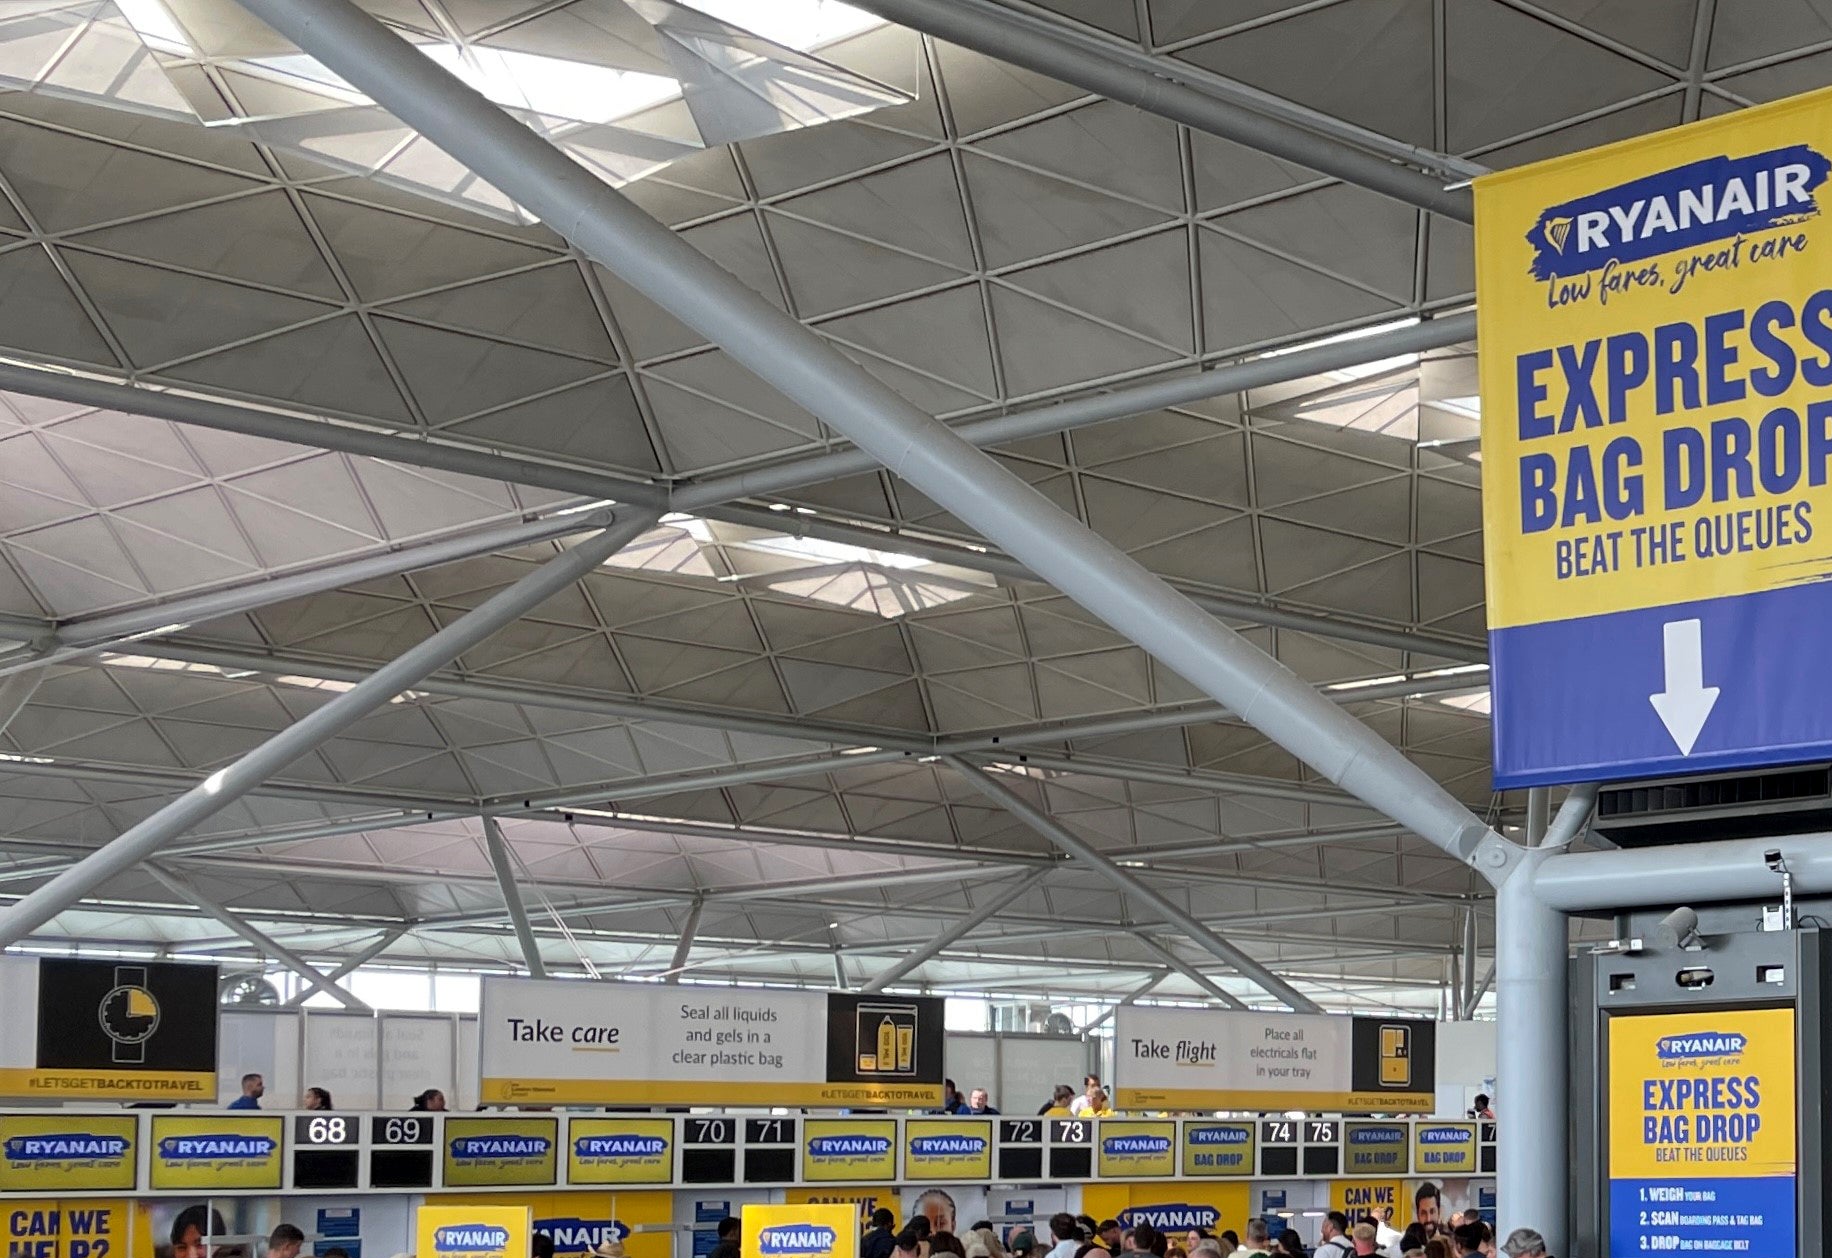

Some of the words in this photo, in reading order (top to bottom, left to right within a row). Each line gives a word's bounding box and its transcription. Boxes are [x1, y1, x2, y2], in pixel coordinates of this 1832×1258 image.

[1577, 163, 1811, 254] RYANAIR
[1547, 270, 1592, 308] Low
[1600, 260, 1666, 306] fares,
[1670, 246, 1742, 294] great
[1750, 230, 1808, 264] care
[1519, 436, 1644, 536] BAG
[1555, 519, 1626, 581] BEAT
[1630, 512, 1686, 567] THE
[1693, 500, 1812, 559] QUEUES
[681, 1004, 710, 1020] Seal
[713, 1006, 729, 1020] all
[733, 1006, 778, 1024] liquids
[507, 1018, 564, 1043] Take
[571, 1026, 620, 1044] care
[685, 1028, 711, 1043] and
[716, 1028, 743, 1046] gels
[747, 1030, 758, 1043] in
[763, 1033, 771, 1043] a
[1265, 1028, 1290, 1040] Place
[1293, 1029, 1304, 1040] all
[1132, 1039, 1170, 1058] Take
[1175, 1040, 1217, 1063] flight
[1671, 1038, 1742, 1053] RYANAIR
[672, 1050, 705, 1065] clear
[710, 1050, 755, 1068] plastic
[758, 1052, 783, 1068] bag
[1250, 1047, 1299, 1059] electricals
[1301, 1049, 1317, 1060] flat
[1662, 1059, 1676, 1068] Low
[1723, 1058, 1741, 1066] care
[1256, 1066, 1266, 1075] in
[1268, 1067, 1290, 1079] your
[1292, 1068, 1311, 1080] tray
[29, 1077, 203, 1091] #LETSGETBACKTOTRAVEL
[1643, 1076, 1761, 1110] EXPRESS
[309, 1118, 346, 1143] 68
[385, 1119, 420, 1143] 69
[695, 1120, 725, 1142] 70
[757, 1120, 782, 1142] 71
[1009, 1121, 1034, 1142] 72
[1060, 1121, 1084, 1142] 73
[1199, 1130, 1247, 1141] RYANAIR
[1270, 1123, 1290, 1142] 74
[1312, 1123, 1332, 1142] 75
[1428, 1131, 1470, 1141] RYANAIR
[1488, 1125, 1497, 1141] 7
[1644, 1115, 1689, 1144] BAG
[1696, 1113, 1761, 1143] DROP
[923, 1138, 983, 1150] RYANAIR
[1358, 1132, 1402, 1141] RYANAIR
[25, 1140, 124, 1154] RYANAIR
[178, 1140, 270, 1154] RYANAIR
[467, 1141, 547, 1153] RYANAIR
[590, 1141, 664, 1153] RYANAIR
[822, 1141, 888, 1152] RYANAIR
[1114, 1140, 1168, 1150] RYANAIR
[1194, 1154, 1214, 1166] BAG
[1217, 1154, 1243, 1166] DROP
[1355, 1153, 1373, 1164] BAG
[1374, 1152, 1398, 1164] DROP
[1424, 1152, 1442, 1163] BAG
[1443, 1152, 1466, 1163] DROP
[1656, 1148, 1681, 1162] BEAT
[1683, 1148, 1703, 1161] THE
[1706, 1147, 1747, 1161] QUEUES
[1345, 1187, 1371, 1206] CAN
[1375, 1187, 1394, 1203] WE
[1640, 1188, 1648, 1202] 1.
[1649, 1187, 1684, 1202] WEIGH
[1685, 1191, 1702, 1201] YOUR
[1703, 1191, 1716, 1201] BAG
[10, 1210, 60, 1237] CAN
[69, 1210, 111, 1234] WE
[1133, 1211, 1214, 1227] RYANAIR
[1640, 1211, 1650, 1226] 2.
[1651, 1211, 1679, 1226] SCAN
[1680, 1215, 1711, 1226] BOARDING
[1712, 1215, 1729, 1226] PASS
[1730, 1215, 1736, 1226] &
[1736, 1215, 1749, 1226] TAG
[1750, 1215, 1763, 1226] BAG
[446, 1231, 507, 1246] RYANAIR
[771, 1231, 832, 1248] RYANAIR
[1640, 1236, 1650, 1250] 3.
[1651, 1236, 1680, 1251] DROP
[1680, 1240, 1693, 1250] BAG
[1694, 1240, 1703, 1250] ON
[1704, 1240, 1733, 1250] BAGGAGE
[1733, 1240, 1750, 1250] BELT
